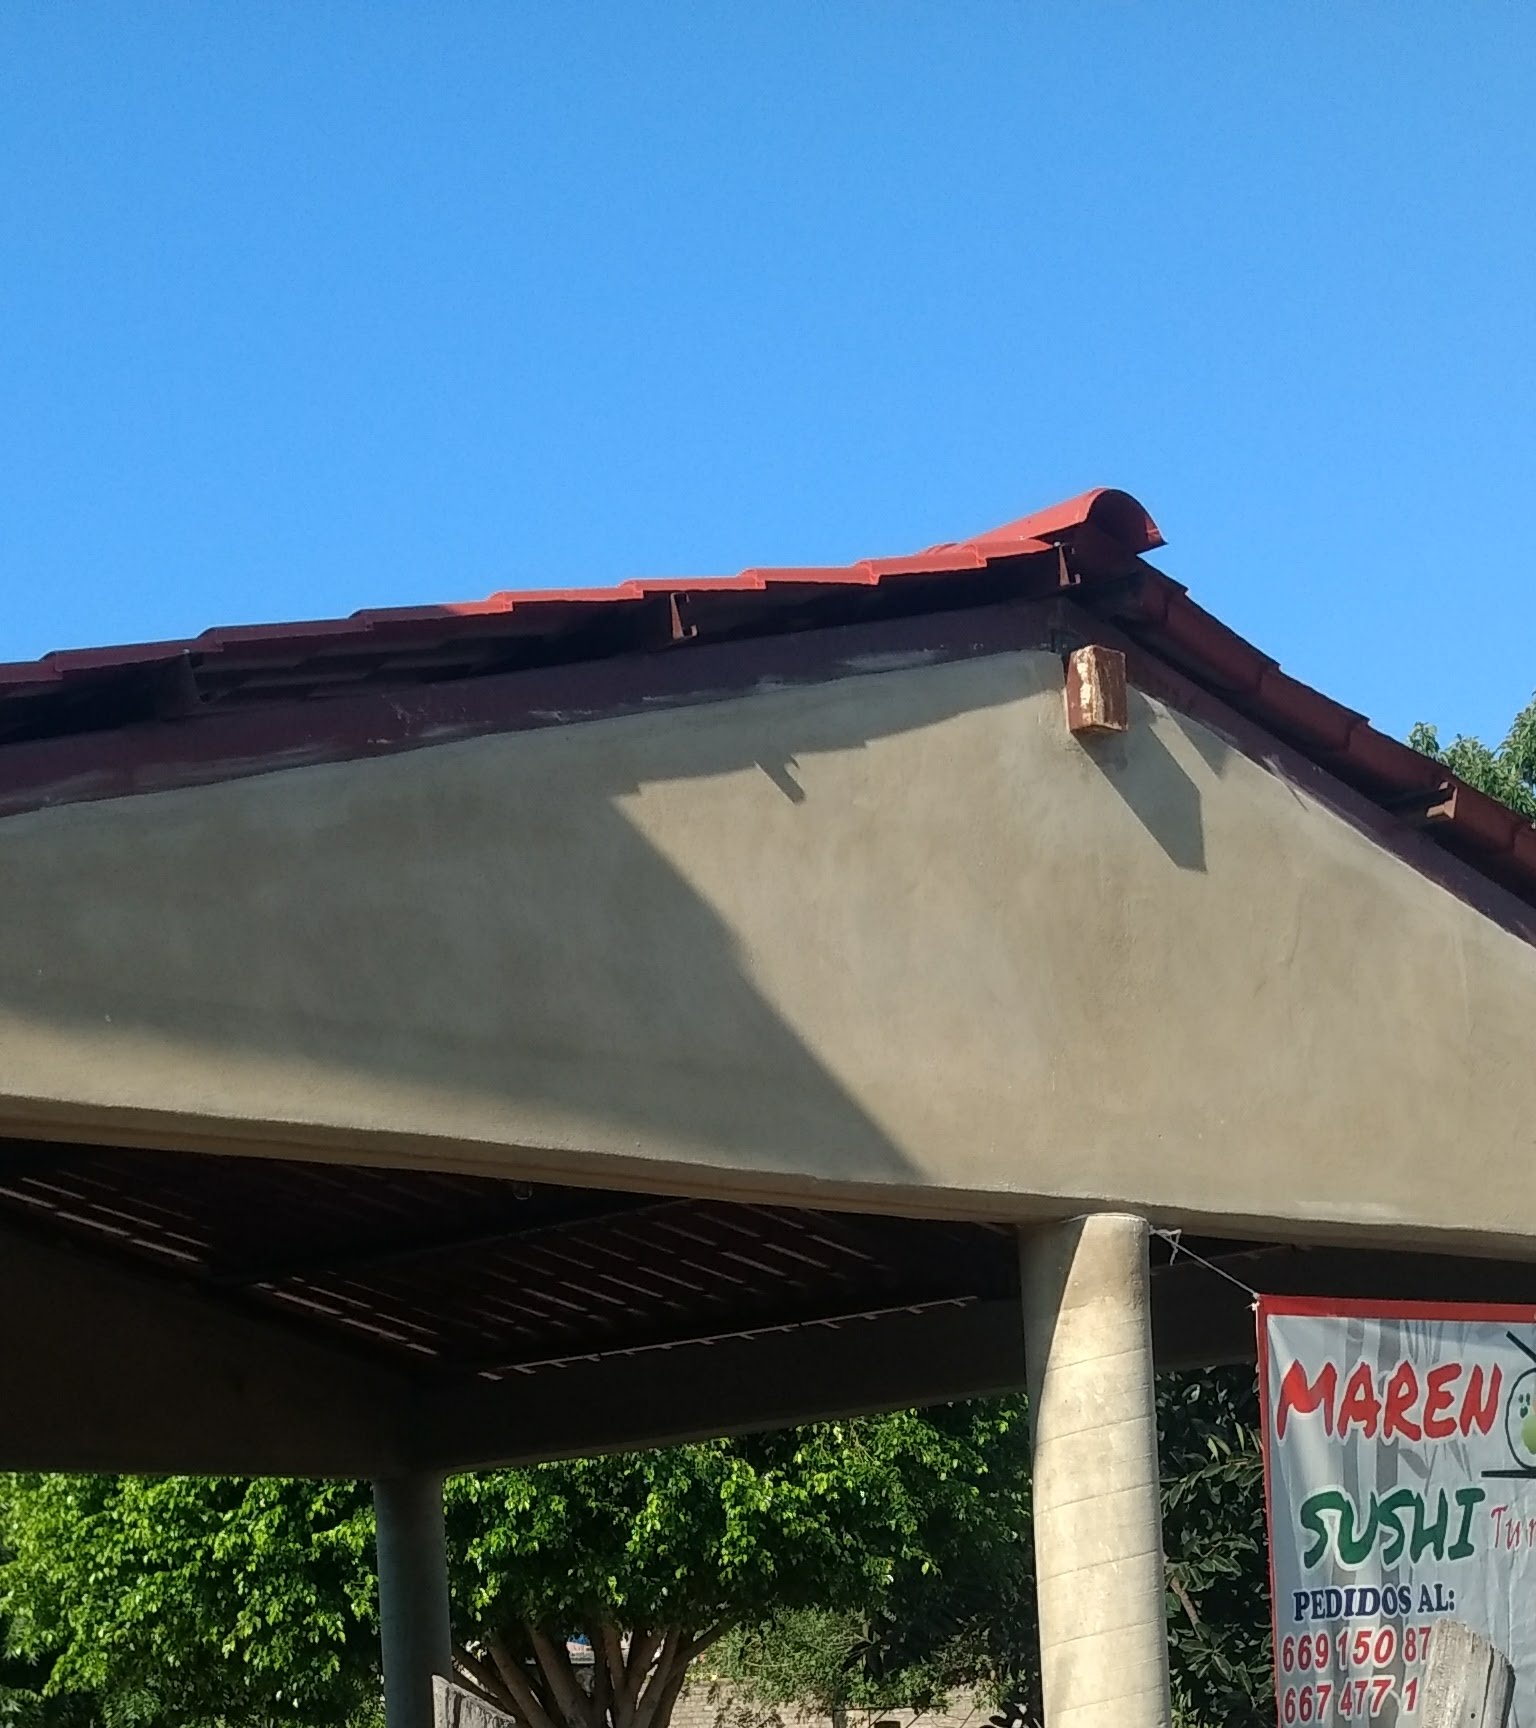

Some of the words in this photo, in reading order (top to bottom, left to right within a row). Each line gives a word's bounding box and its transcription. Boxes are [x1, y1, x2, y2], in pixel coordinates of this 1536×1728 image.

[1276, 1358, 1503, 1442] MAREN
[1300, 1487, 1486, 1570] SUSHI
[1491, 1505, 1521, 1550] Tu
[1293, 1585, 1412, 1621] PEDIDOS
[1417, 1583, 1456, 1613] AL:
[1282, 1632, 1330, 1673] 669
[1337, 1628, 1395, 1672] 150
[1284, 1683, 1332, 1724] 667
[1339, 1678, 1392, 1717] 477
